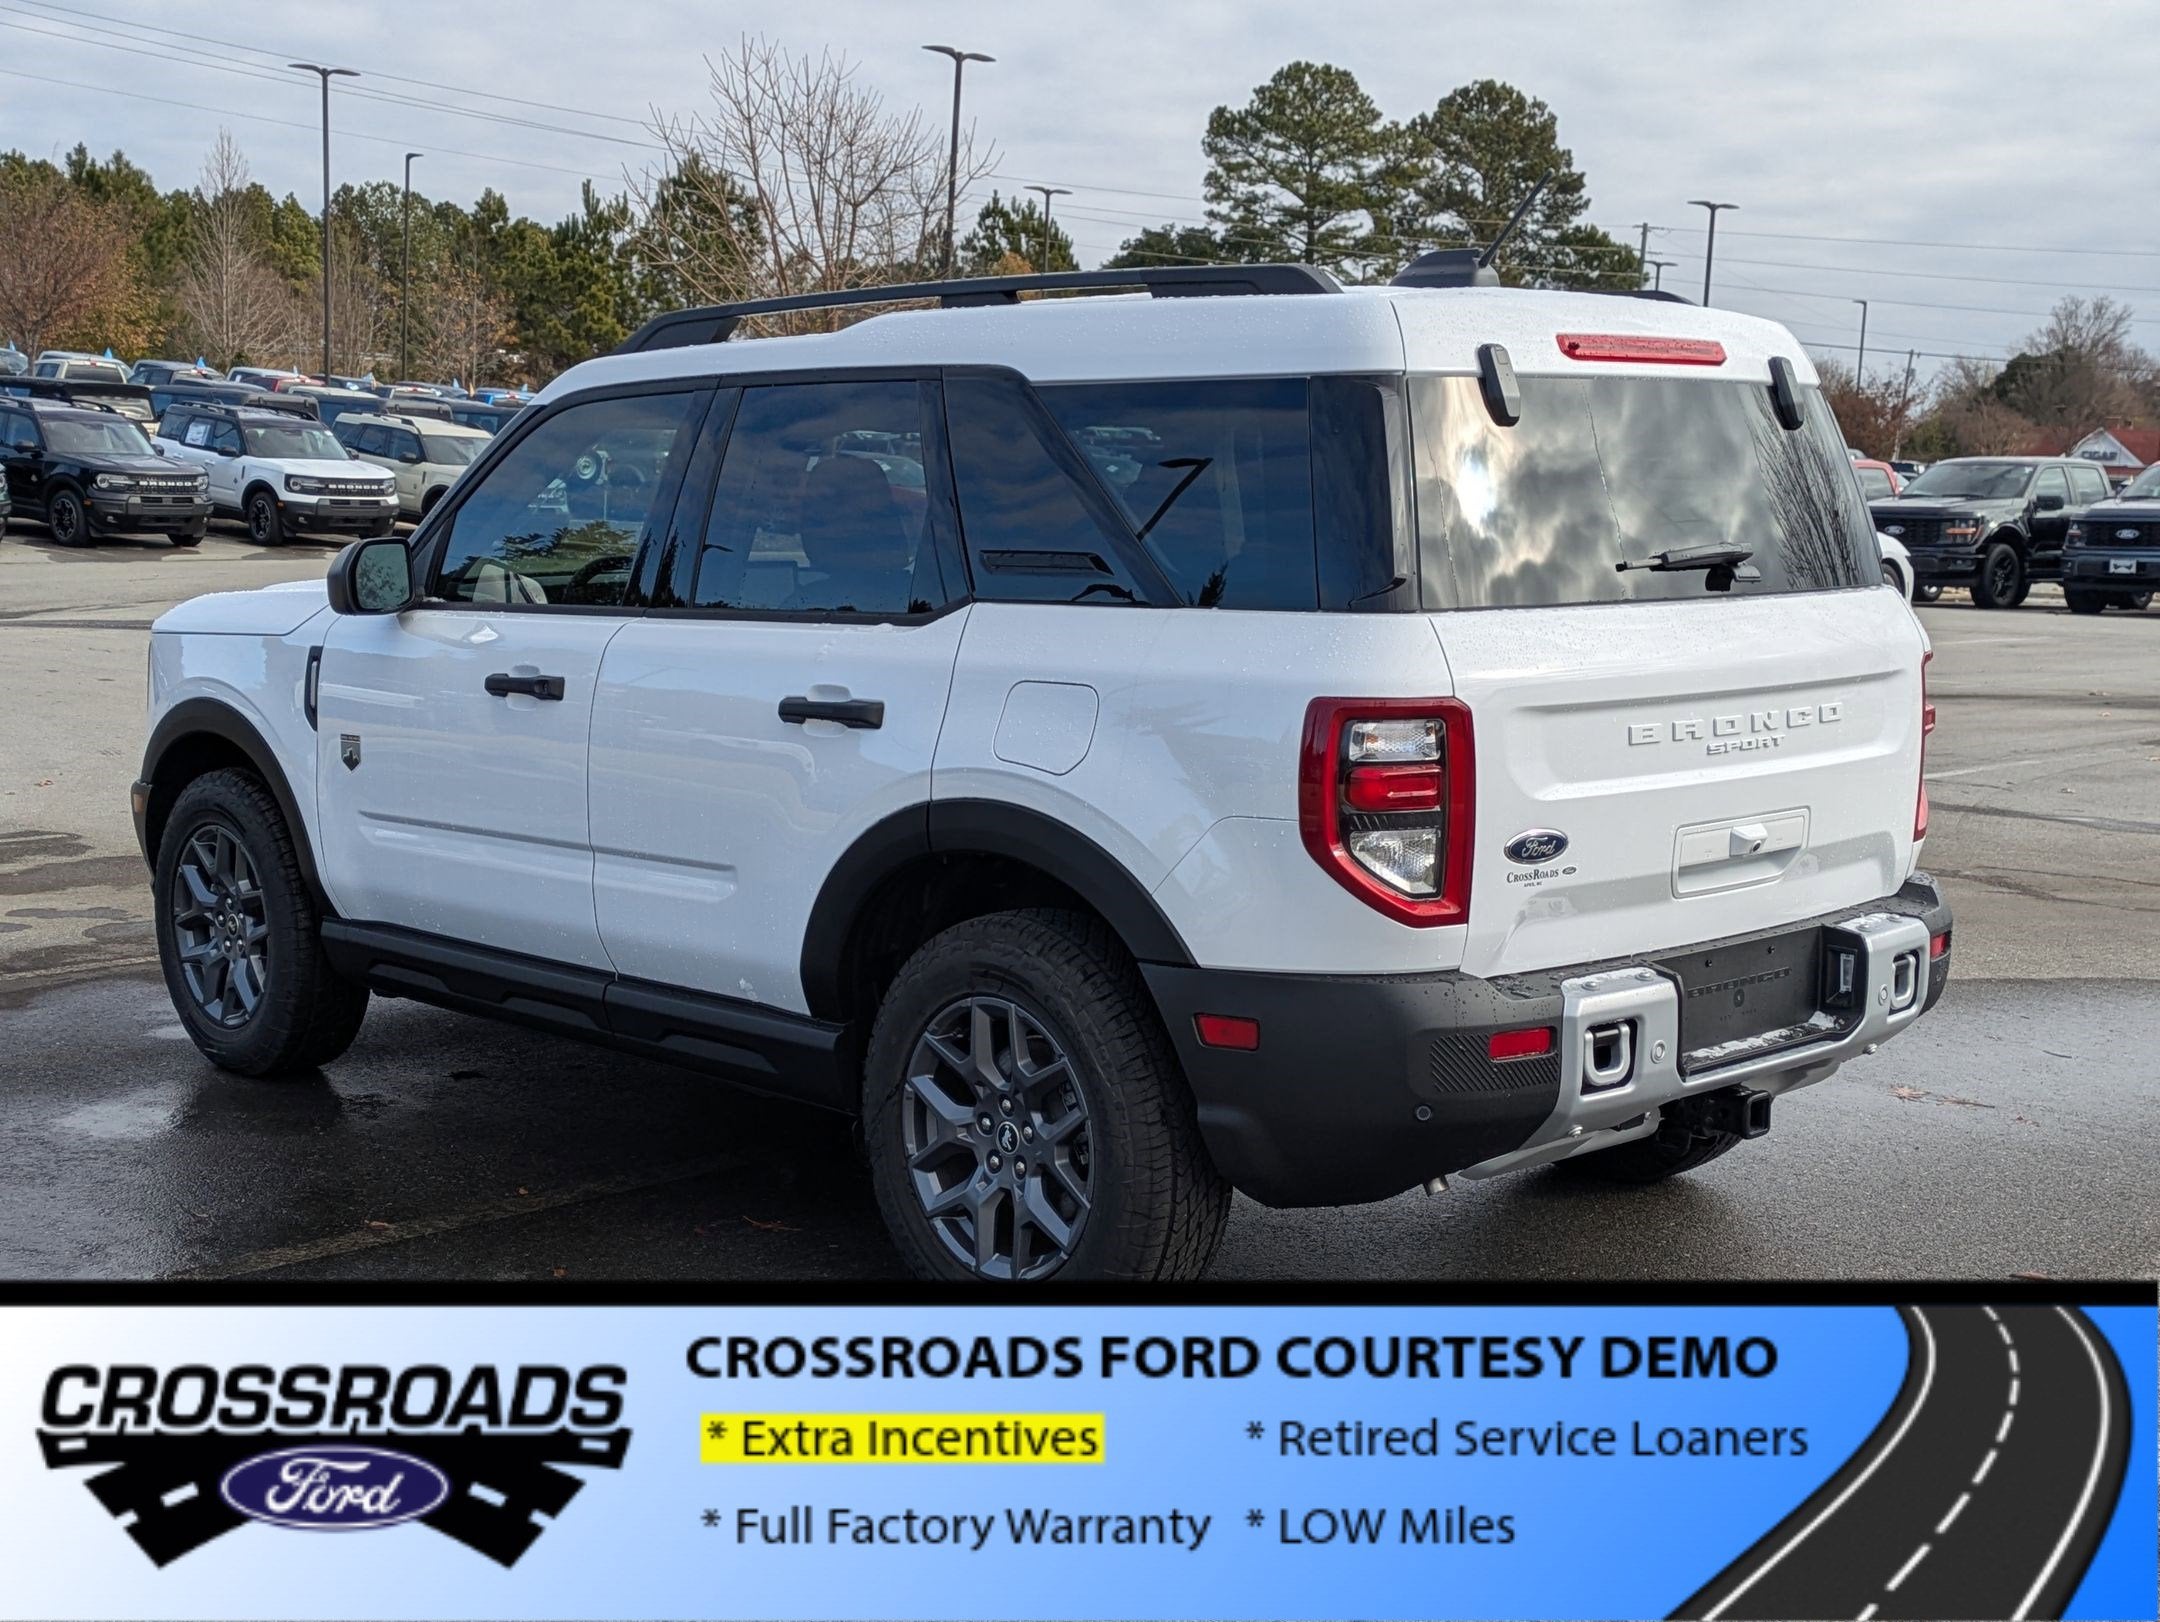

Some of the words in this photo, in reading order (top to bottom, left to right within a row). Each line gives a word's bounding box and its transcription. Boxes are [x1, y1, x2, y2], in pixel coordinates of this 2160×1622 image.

[1628, 701, 1843, 746] BRONCO
[1706, 734, 1786, 755] SPORT
[1521, 836, 1556, 858] Ford
[1687, 966, 1792, 999] BRONCO
